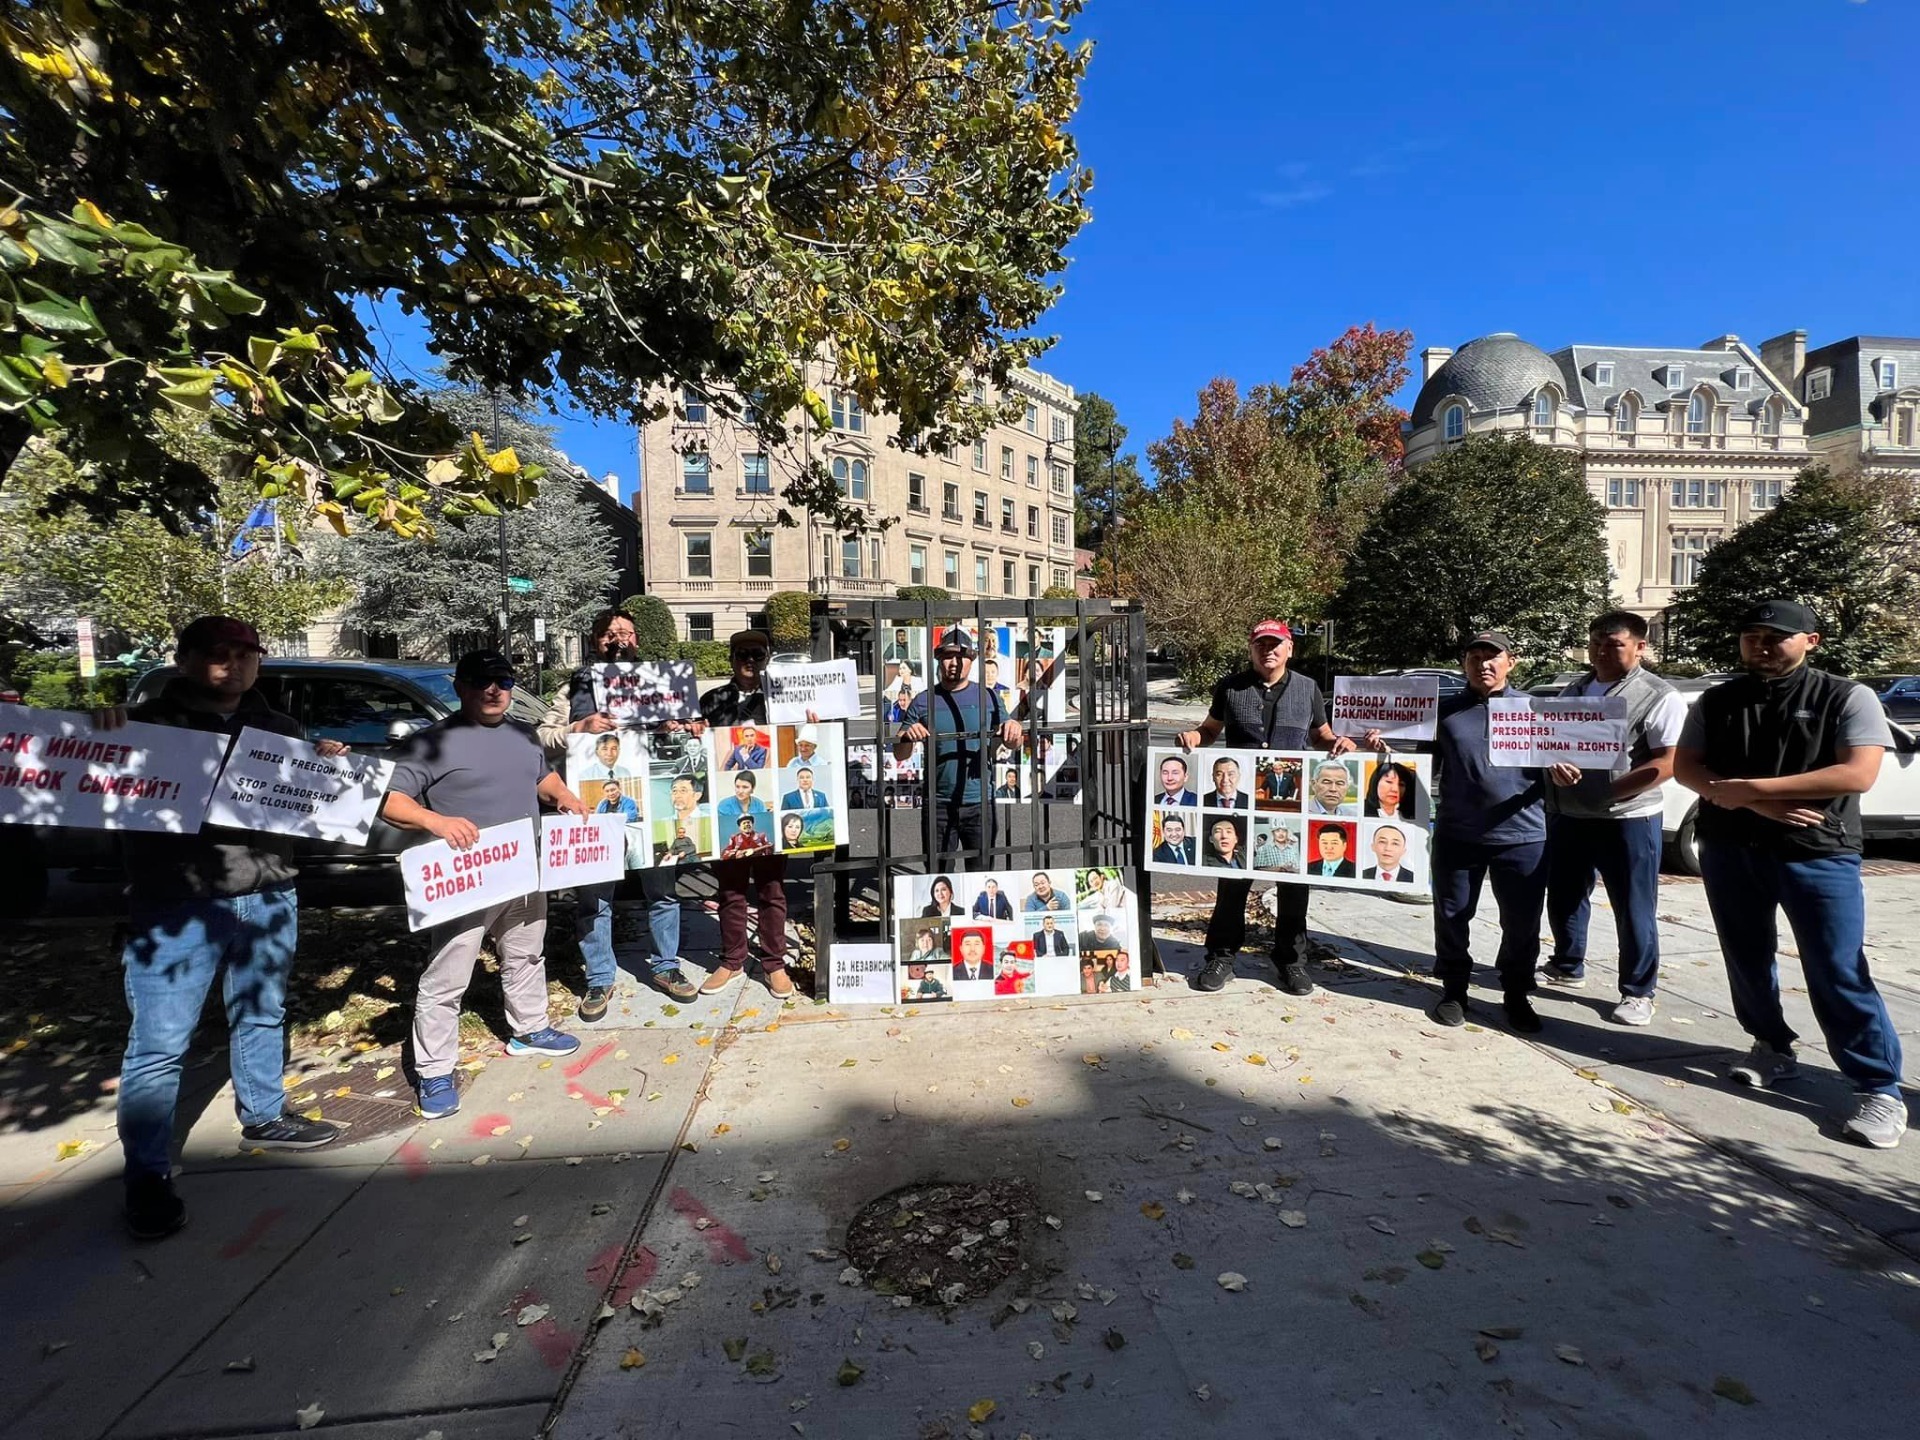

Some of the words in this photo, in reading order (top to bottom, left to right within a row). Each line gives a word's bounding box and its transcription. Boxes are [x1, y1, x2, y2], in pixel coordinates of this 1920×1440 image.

[1334, 695, 1387, 708] СВОБОДУ
[1394, 697, 1435, 709] ПОЛИТ
[1334, 708, 1424, 722] ЗАКЛЮЧЕННЫМ!
[1492, 712, 1537, 722] RELEASE
[1543, 711, 1606, 723] POLITICAL
[1492, 727, 1556, 736] PRISONERS!
[45, 736, 134, 765] ИЙИЛЕТ
[1491, 741, 1531, 751] UPHOLD
[1536, 741, 1570, 751] HUMAN
[1577, 742, 1626, 752] RIGHTS!
[248, 748, 285, 765] MEDIA
[290, 758, 337, 777] FREEDOM
[340, 769, 366, 783] NOW!
[77, 773, 182, 801] СЫНБАЙТ!
[236, 777, 268, 790] STOP
[272, 784, 339, 804] CENSORSHIP
[230, 791, 254, 804] AND
[259, 796, 320, 815] CLOSURES!
[568, 826, 600, 848] ДЕГЕН
[421, 862, 444, 883] ЗА
[453, 839, 520, 874] СВОБОДУ
[549, 849, 569, 869] СЕЛ
[574, 845, 610, 865] БОЛОТ!
[424, 871, 484, 903] СЛОВА!
[836, 960, 847, 973] ЗА
[836, 975, 864, 989] СУДОВ!
